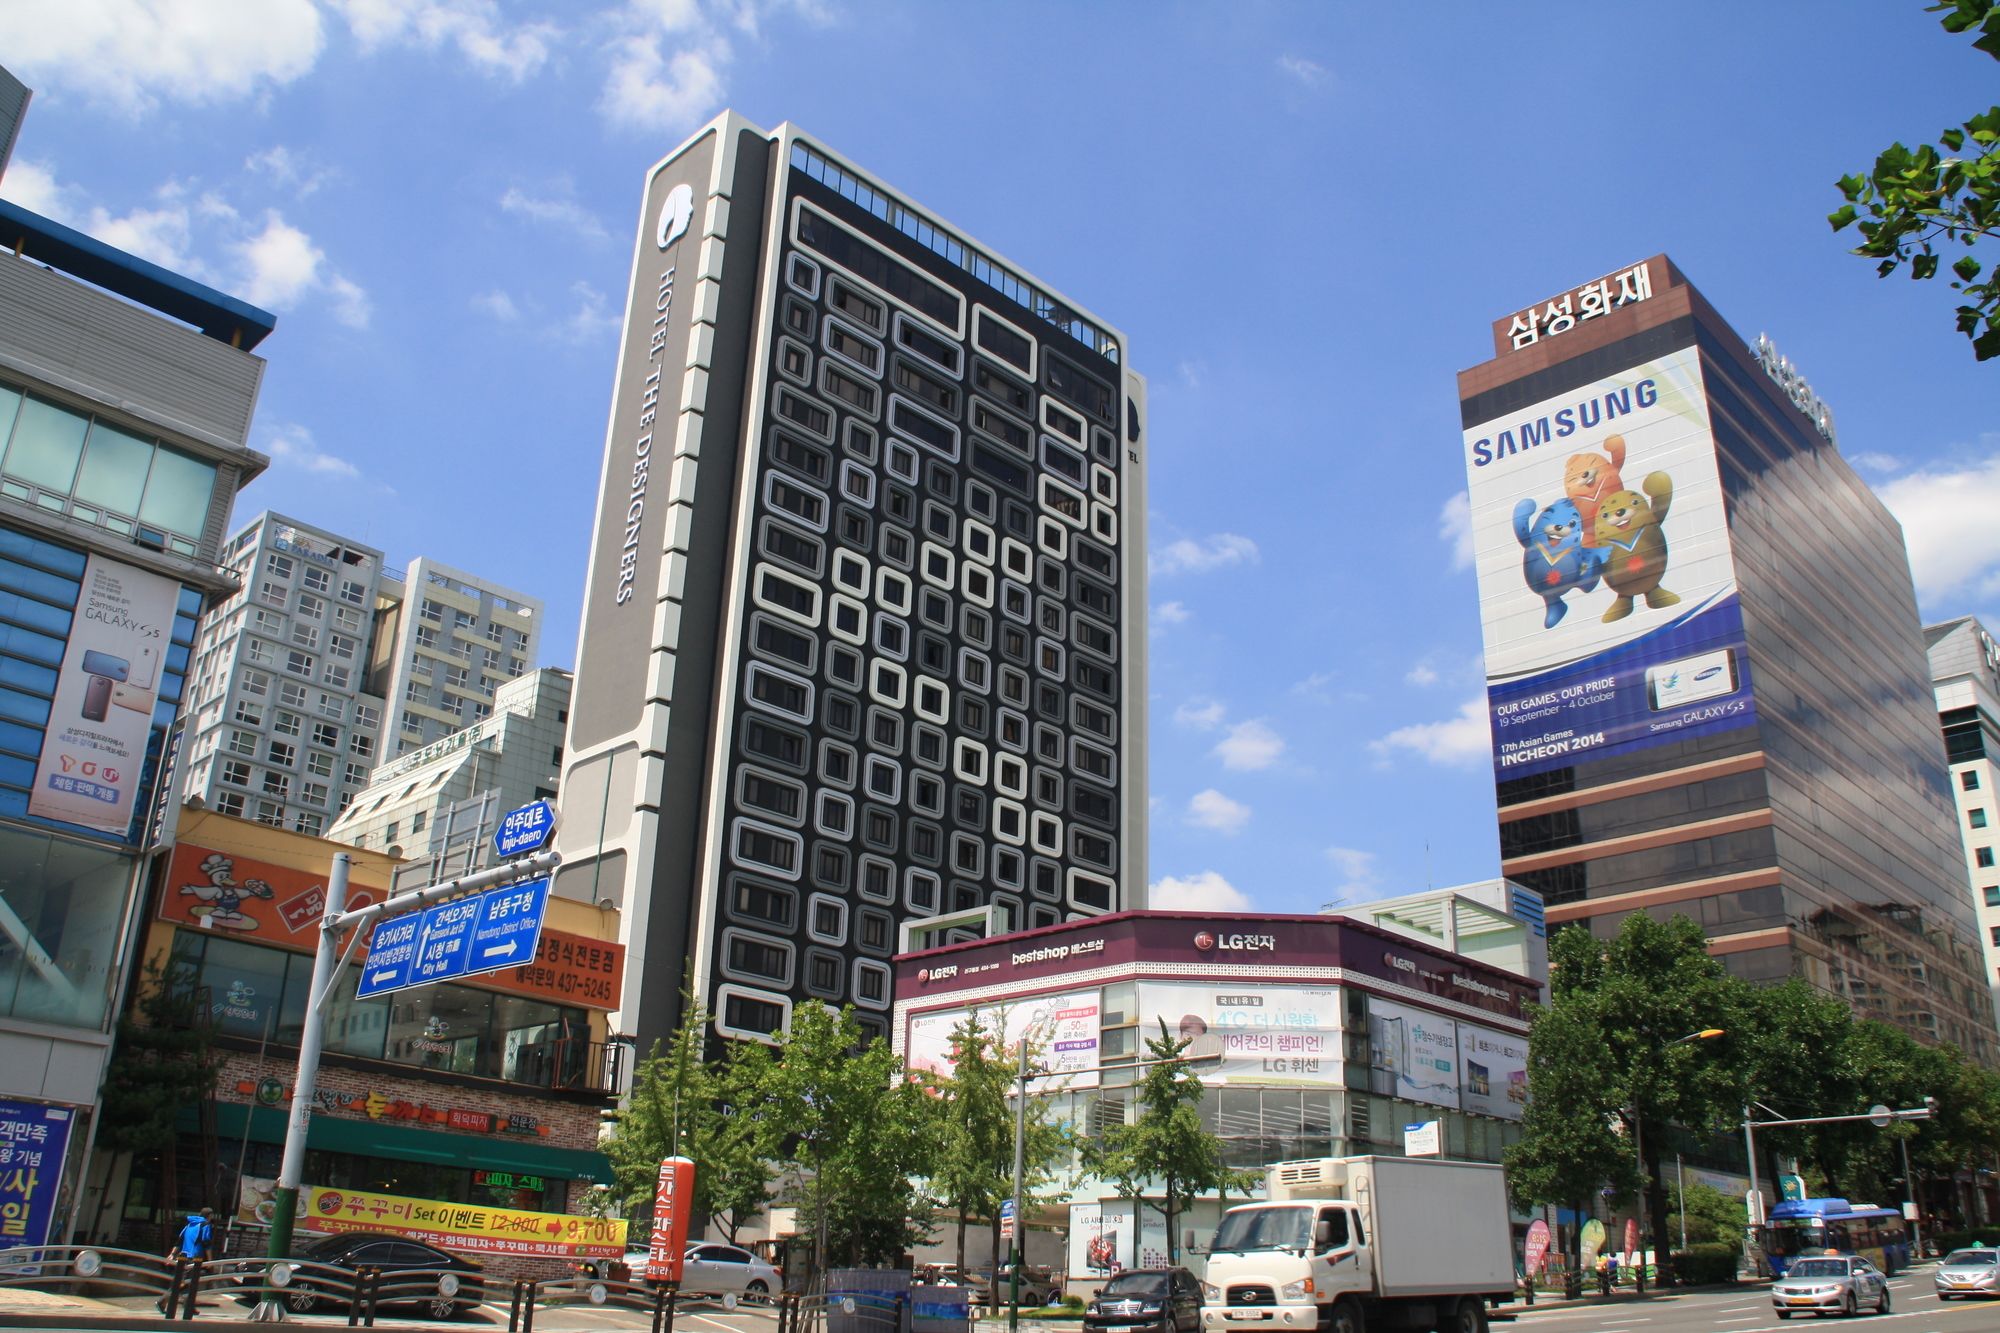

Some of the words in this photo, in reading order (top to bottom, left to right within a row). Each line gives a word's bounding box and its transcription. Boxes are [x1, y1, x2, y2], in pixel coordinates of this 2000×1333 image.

[649, 266, 676, 363] HOTEL
[1507, 263, 1653, 350] 삼성화재
[640, 364, 662, 429] THE
[1473, 379, 1658, 467] SAMSUNG
[616, 431, 653, 606] DESIGNERS
[85, 607, 139, 631] GALAXY
[89, 597, 129, 617] Samsung
[1497, 703, 1519, 716] OUR
[1561, 685, 1584, 699] OUR
[1585, 677, 1616, 693] PRIDE
[1500, 717, 1510, 727] 19
[1510, 704, 1561, 724] September
[1568, 699, 1576, 709] 4
[1577, 690, 1616, 707] October
[1650, 719, 1683, 732] Samsung
[1683, 704, 1726, 723] GALAXY
[1500, 741, 1518, 753] 17th
[1519, 734, 1543, 749] Asian
[1543, 729, 1574, 742] Games
[1501, 740, 1569, 766] INCHEON
[1571, 731, 1605, 749] 2014
[504, 806, 544, 836] 인주대로
[502, 830, 542, 851] Inju-daero
[435, 902, 478, 928] 간석오거리
[488, 890, 535, 921] 남동구청
[376, 922, 417, 949] 승기사거리
[1218, 934, 1276, 951] LG전자
[426, 941, 447, 960] 시청
[929, 965, 958, 980] LG전자
[1012, 945, 1069, 966] bestshop
[1071, 939, 1105, 954] 베스트샵
[422, 962, 436, 976] City
[436, 959, 449, 972] Hall
[557, 972, 611, 1001] 437-5245
[1452, 973, 1491, 996] bestshop
[1277, 1035, 1325, 1053] 챔피언!
[1262, 1058, 1287, 1073] LG
[1290, 1058, 1320, 1073] 휘센
[1, 1120, 48, 1144] 객만족
[451, 1111, 489, 1128] 화덕피자
[16, 1150, 43, 1167] 기념
[1077, 1180, 1089, 1191] PC
[345, 1196, 413, 1221] 쭈꾸미
[413, 1207, 436, 1221] Set
[438, 1208, 487, 1229] 이벤트
[566, 1220, 618, 1242] 9,700
